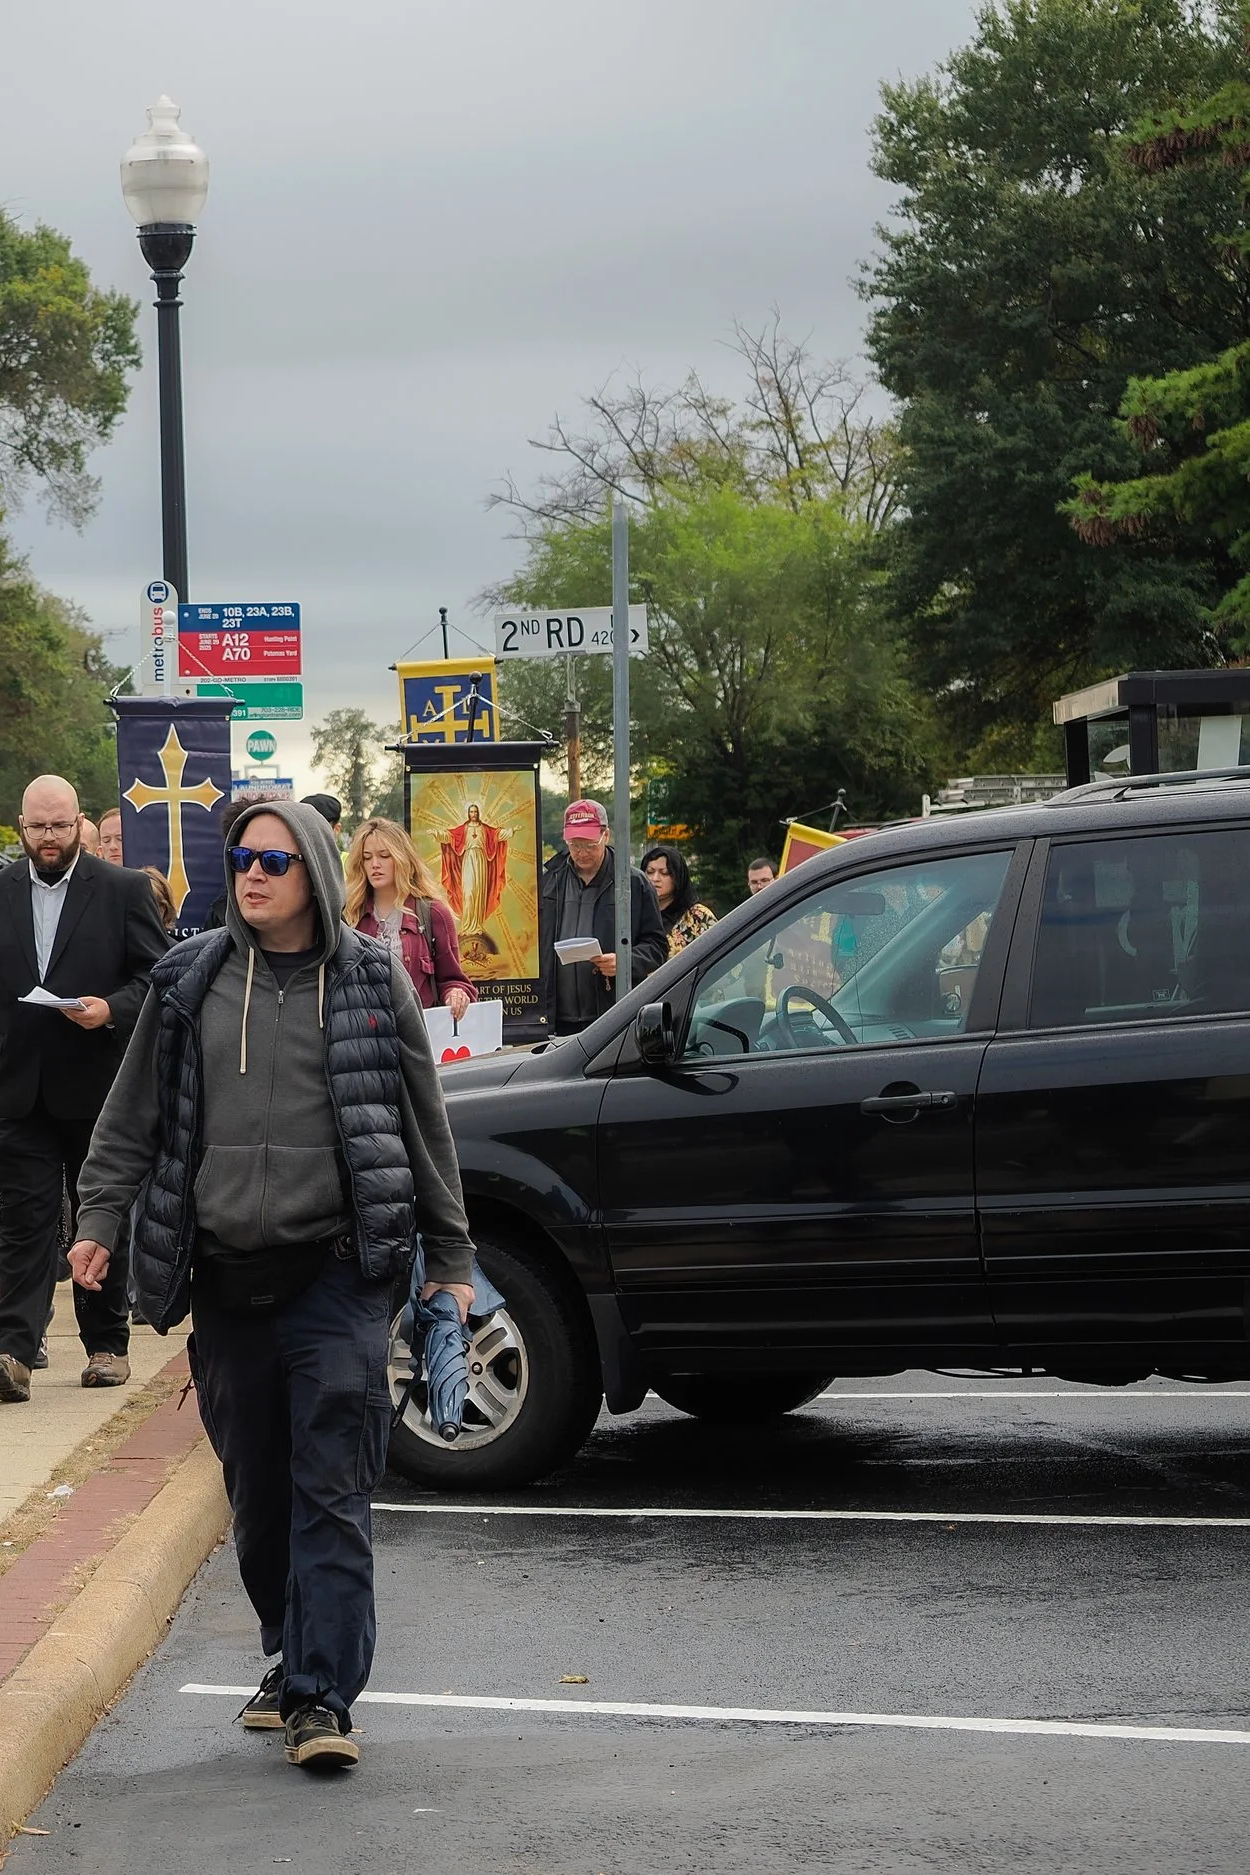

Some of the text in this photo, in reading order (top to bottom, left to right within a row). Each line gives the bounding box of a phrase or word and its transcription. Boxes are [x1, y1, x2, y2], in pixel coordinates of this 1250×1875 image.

[222, 606, 295, 617] 10B, 23A, 23B,
[222, 619, 243, 628] 23T
[222, 633, 249, 646] A12
[501, 619, 541, 652] 2ND
[546, 616, 585, 649] RD
[152, 607, 164, 682] metrobus
[222, 647, 251, 661] A70
[247, 739, 276, 753] PAWN
[492, 985, 505, 994] OF
[507, 984, 532, 995] JESUS
[505, 994, 539, 1005] WORLD
[510, 1007, 522, 1016] US
